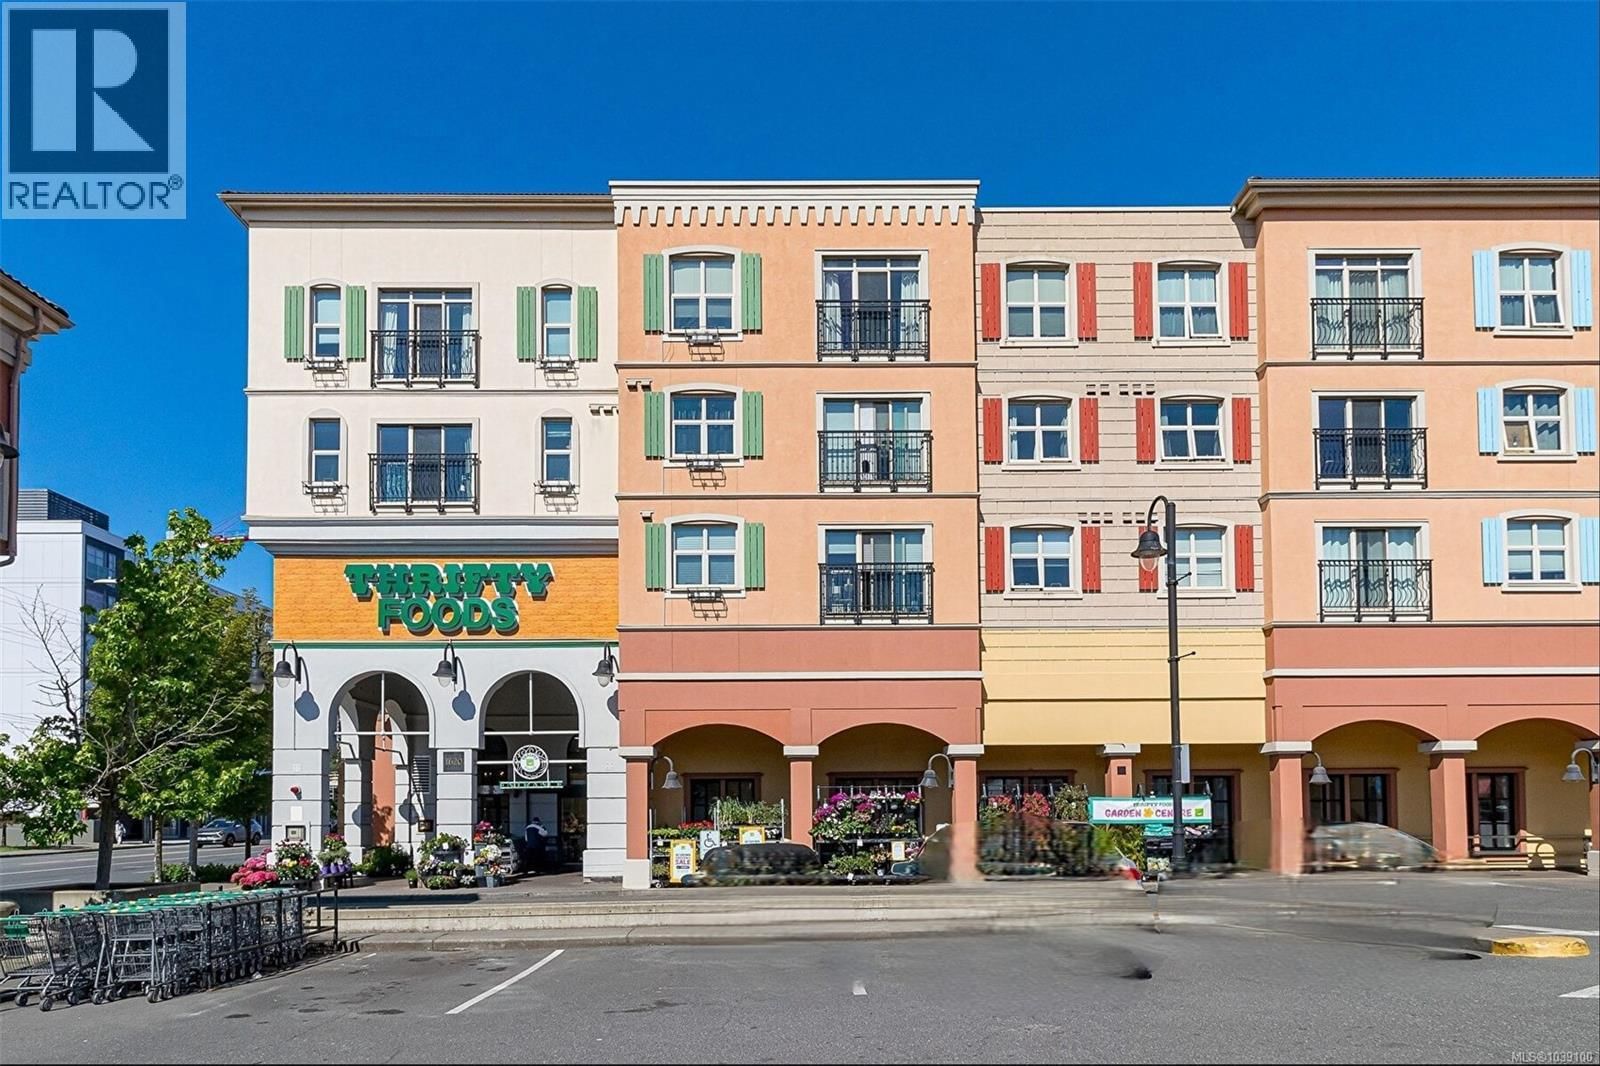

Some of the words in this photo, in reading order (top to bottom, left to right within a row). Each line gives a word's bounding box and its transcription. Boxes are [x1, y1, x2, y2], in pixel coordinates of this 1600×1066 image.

[344, 562, 555, 599] THRIFTY
[378, 597, 519, 633] FOODS
[1104, 809, 1142, 818] GARDEN
[1155, 808, 1192, 818] CENRE
